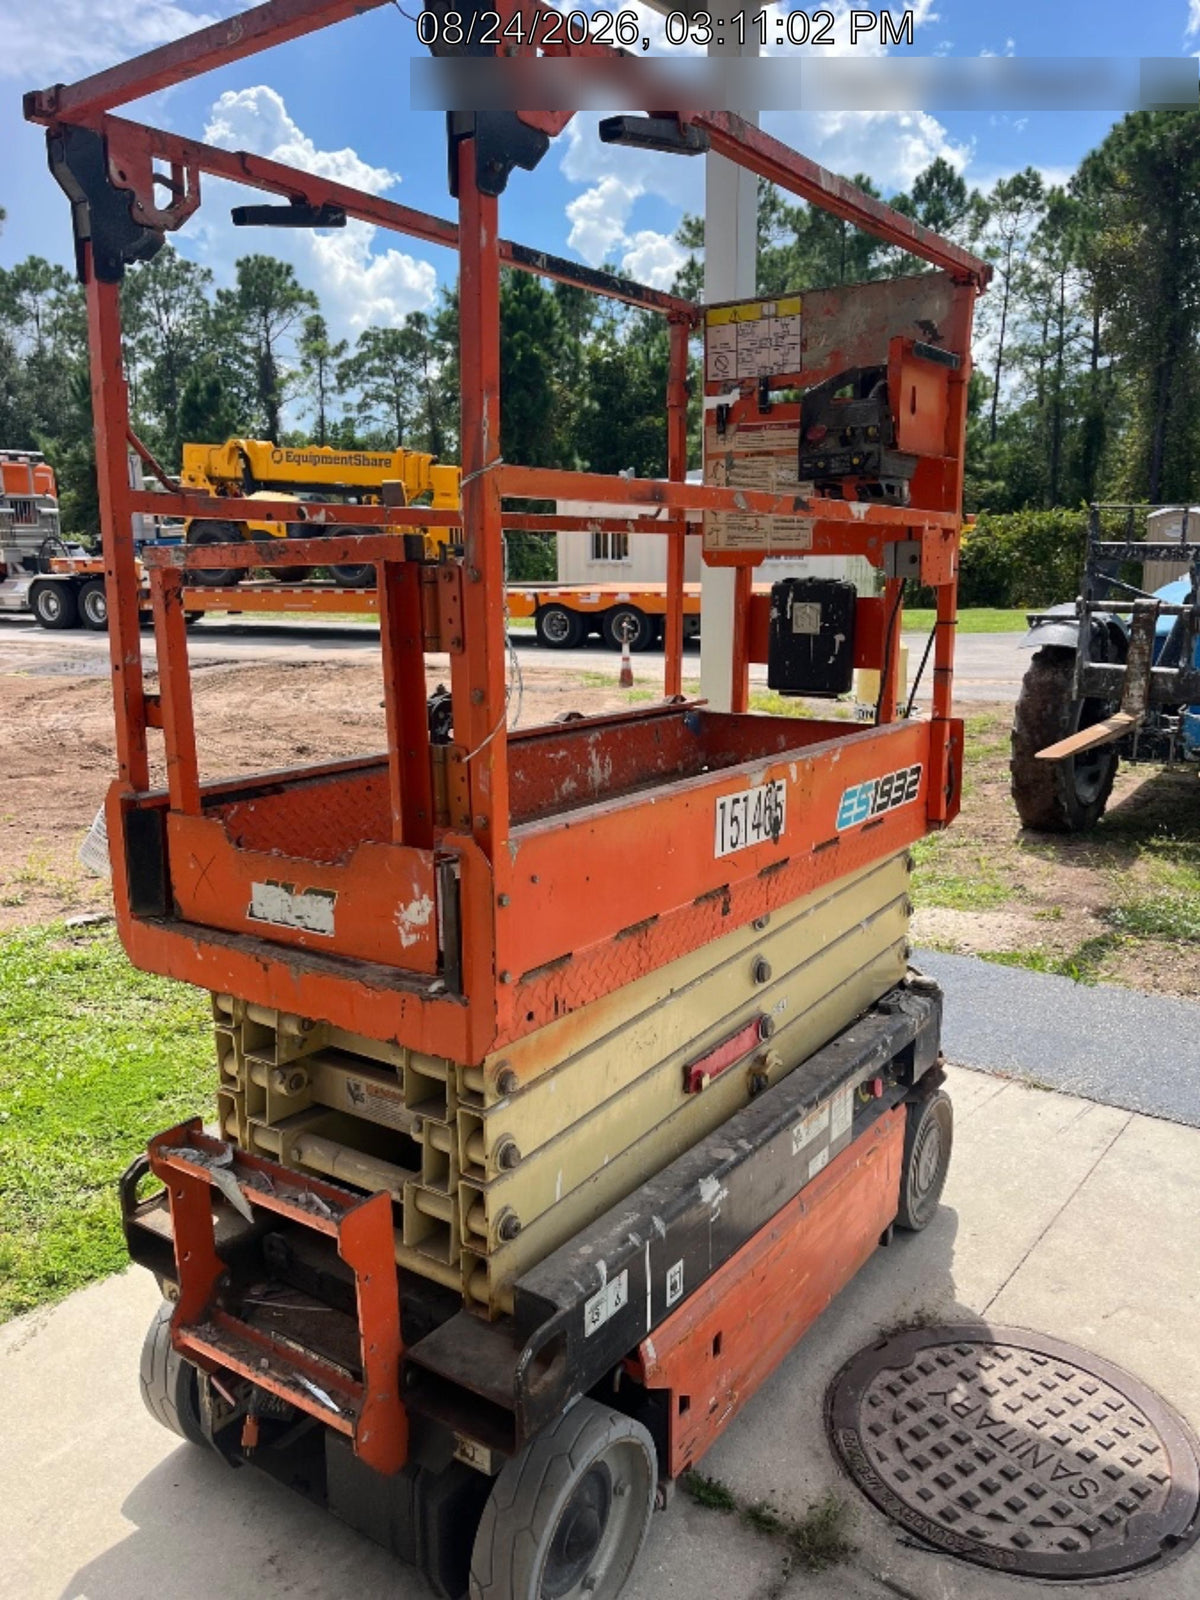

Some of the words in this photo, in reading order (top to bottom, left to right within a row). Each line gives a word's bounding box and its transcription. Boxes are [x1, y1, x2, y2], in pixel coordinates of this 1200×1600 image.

[285, 450, 392, 468] EquipmentShare
[719, 784, 784, 853] 151465
[836, 765, 922, 830] ES1932
[928, 1389, 1099, 1500] SANITARY
